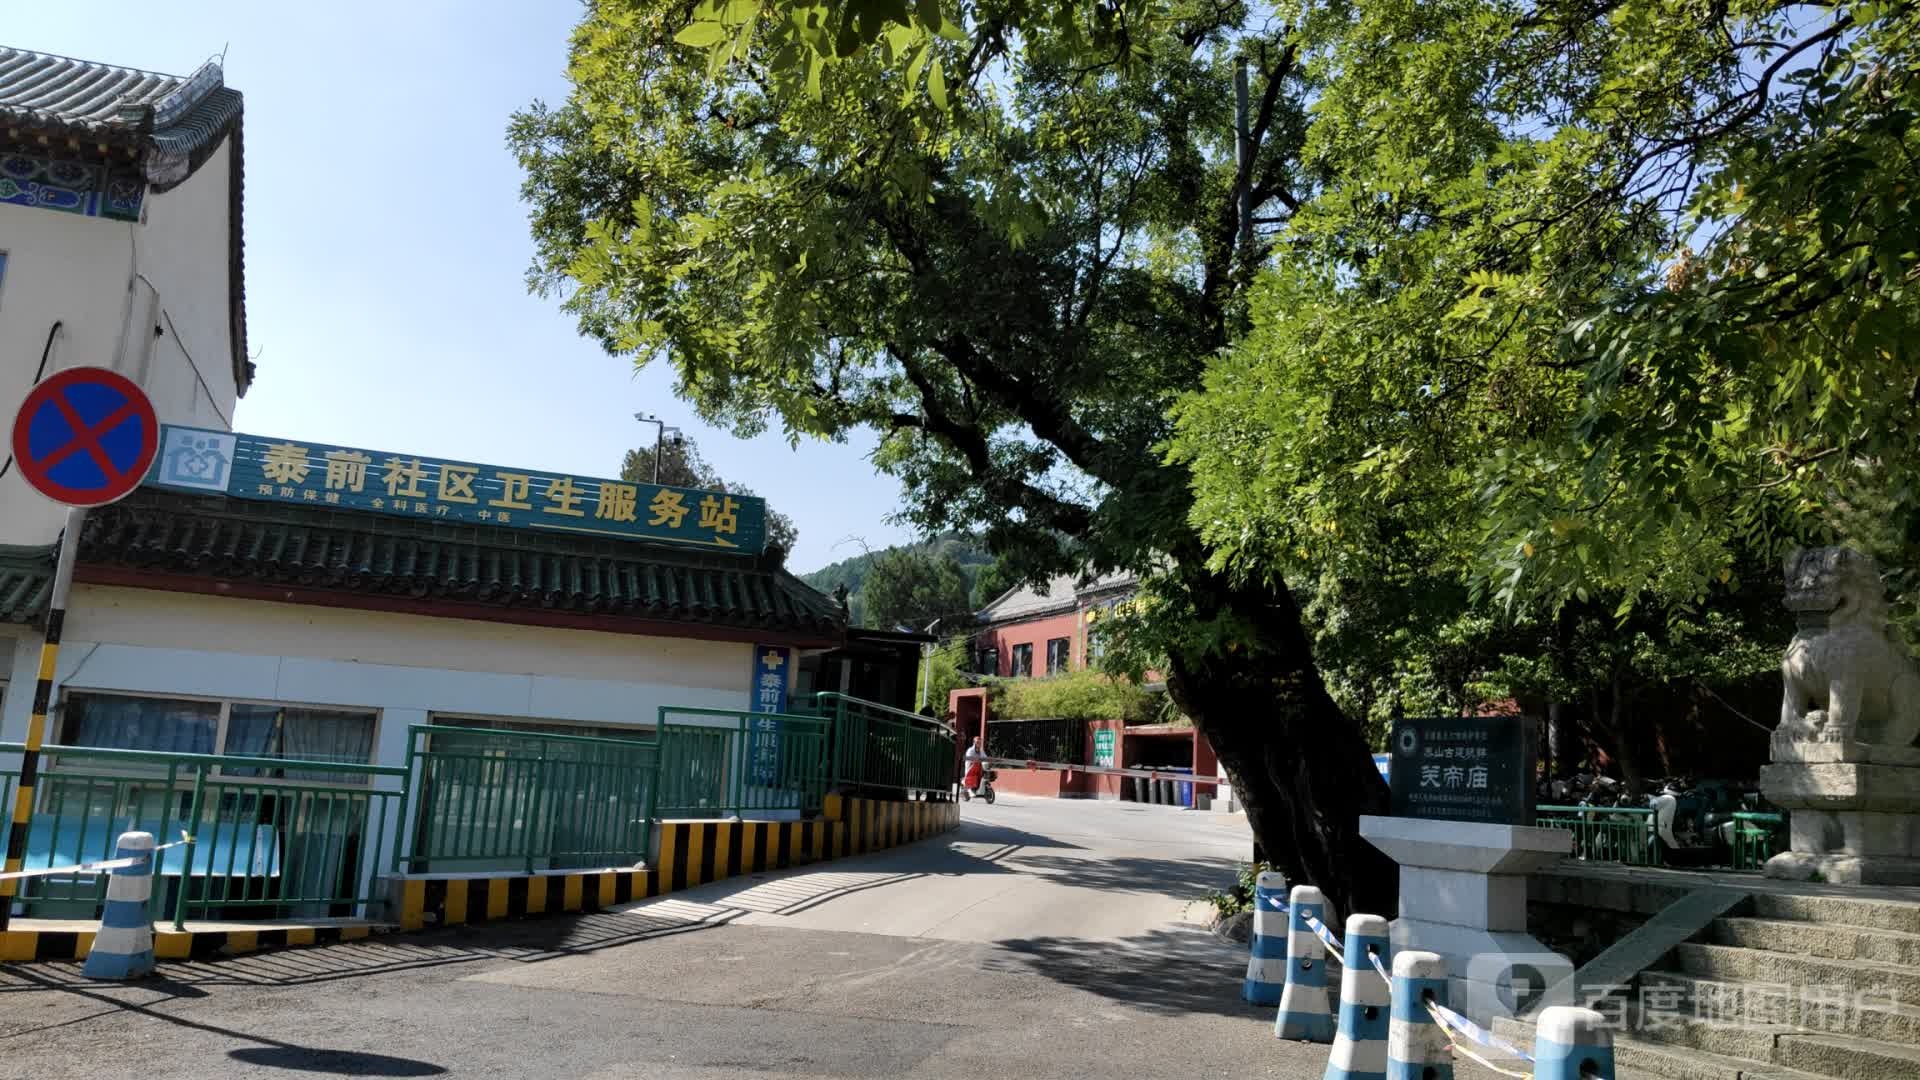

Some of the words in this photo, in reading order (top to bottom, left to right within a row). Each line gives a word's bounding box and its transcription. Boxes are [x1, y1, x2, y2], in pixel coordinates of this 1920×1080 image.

[261, 442, 740, 535] 泰前社区卫生服务站
[1419, 765, 1488, 789] 关帝庙
